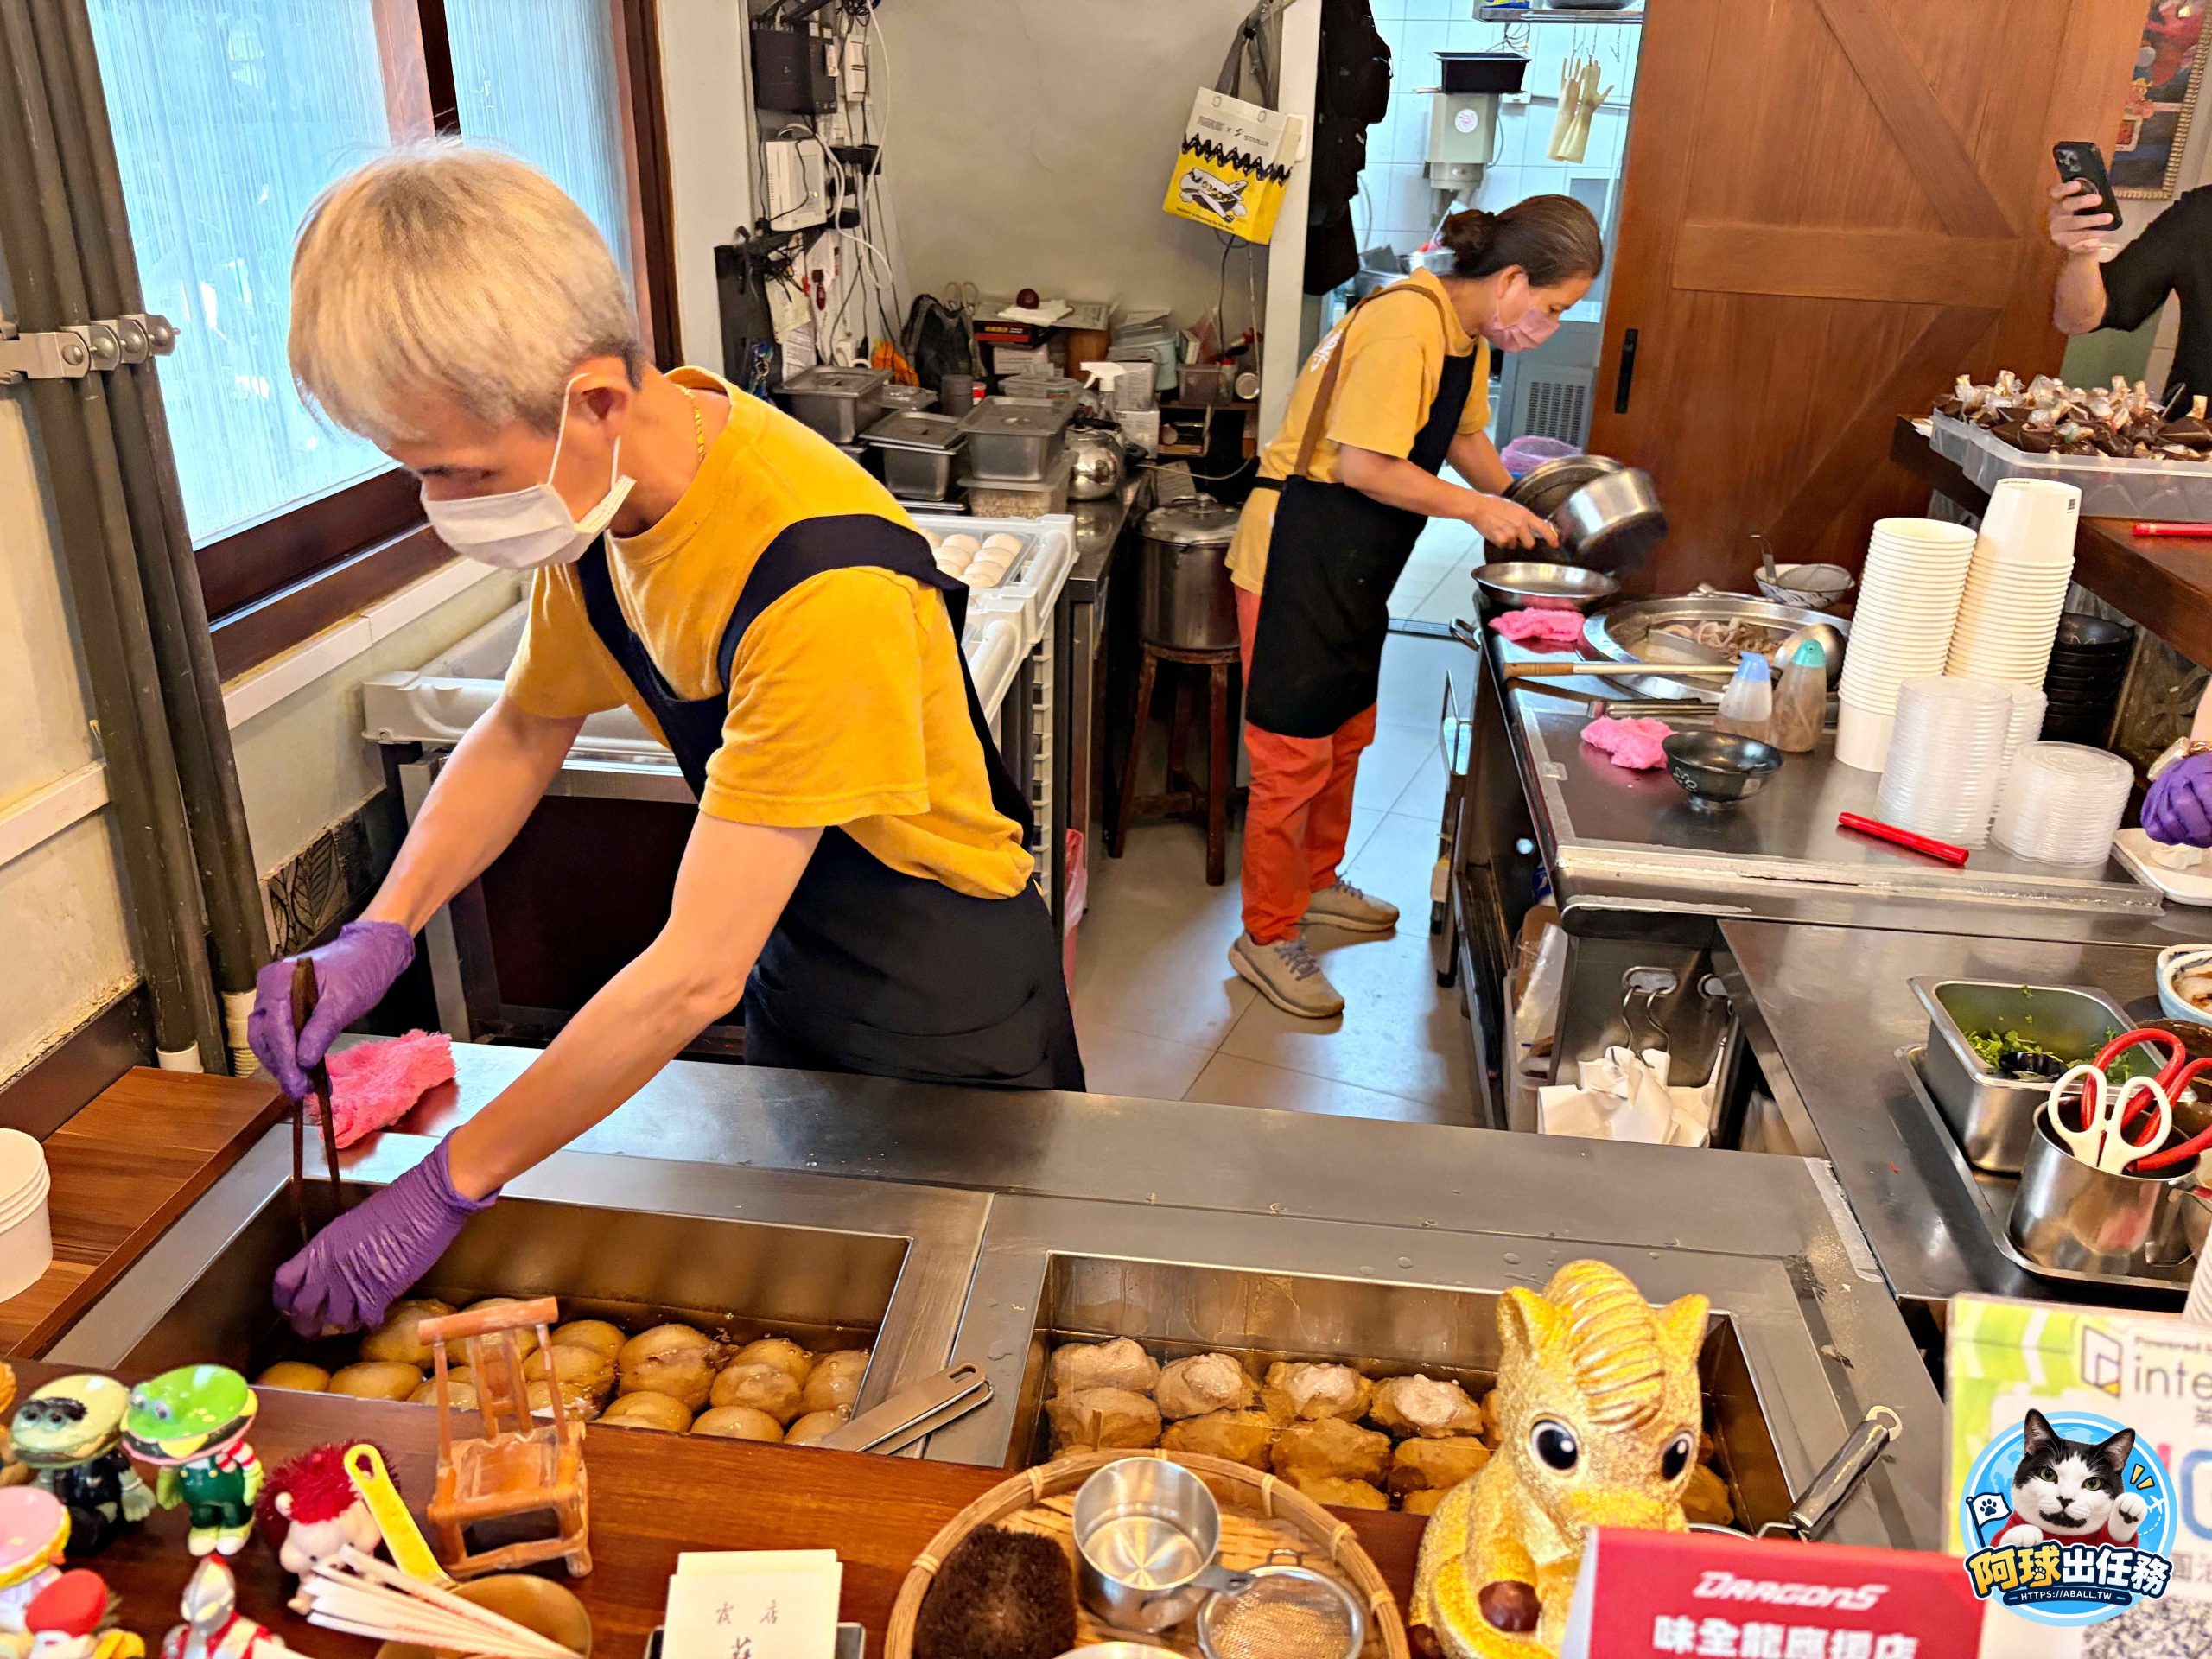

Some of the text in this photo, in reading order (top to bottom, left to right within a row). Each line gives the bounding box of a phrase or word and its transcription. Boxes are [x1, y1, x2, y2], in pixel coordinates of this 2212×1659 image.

[1652, 1615, 1919, 1659] 味全龍應援店
